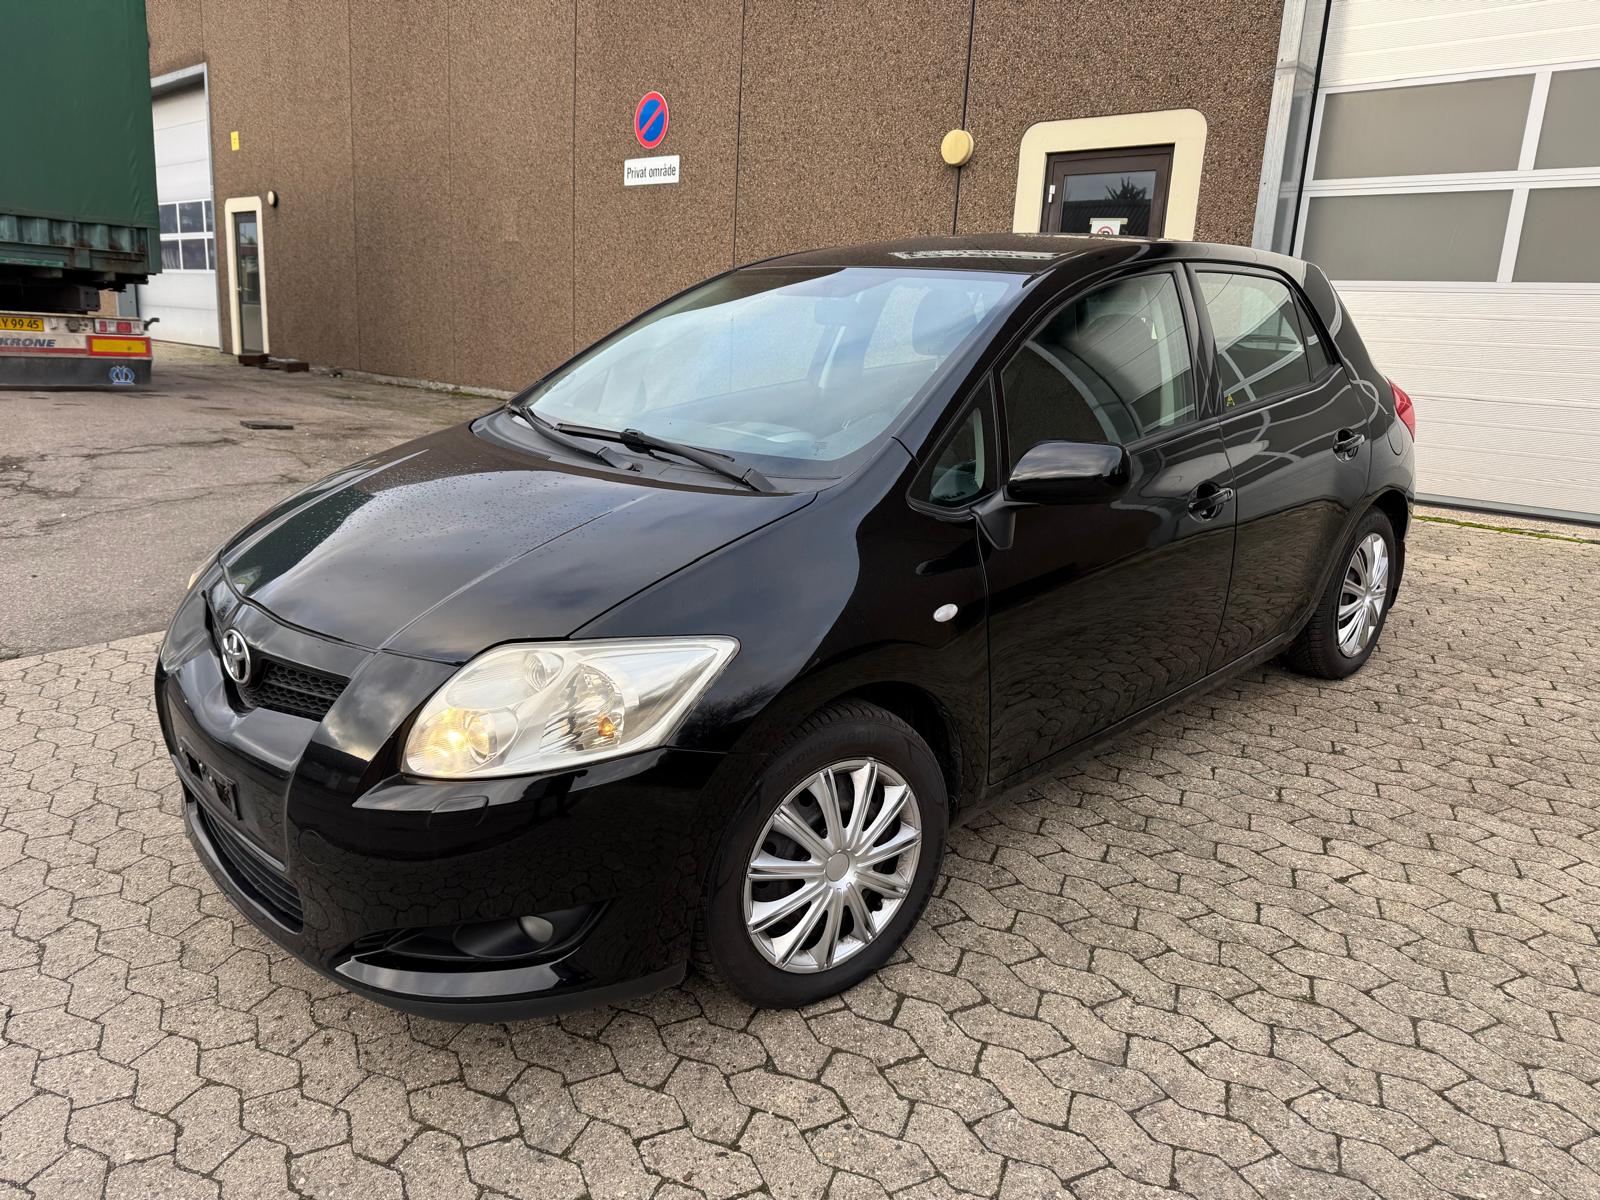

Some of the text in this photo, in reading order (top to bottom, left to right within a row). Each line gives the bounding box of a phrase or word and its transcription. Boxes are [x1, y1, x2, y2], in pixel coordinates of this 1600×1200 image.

[626, 163, 677, 179] Privat område
[11, 318, 24, 328] 99
[27, 319, 39, 329] 45
[0, 337, 56, 347] KRONE
